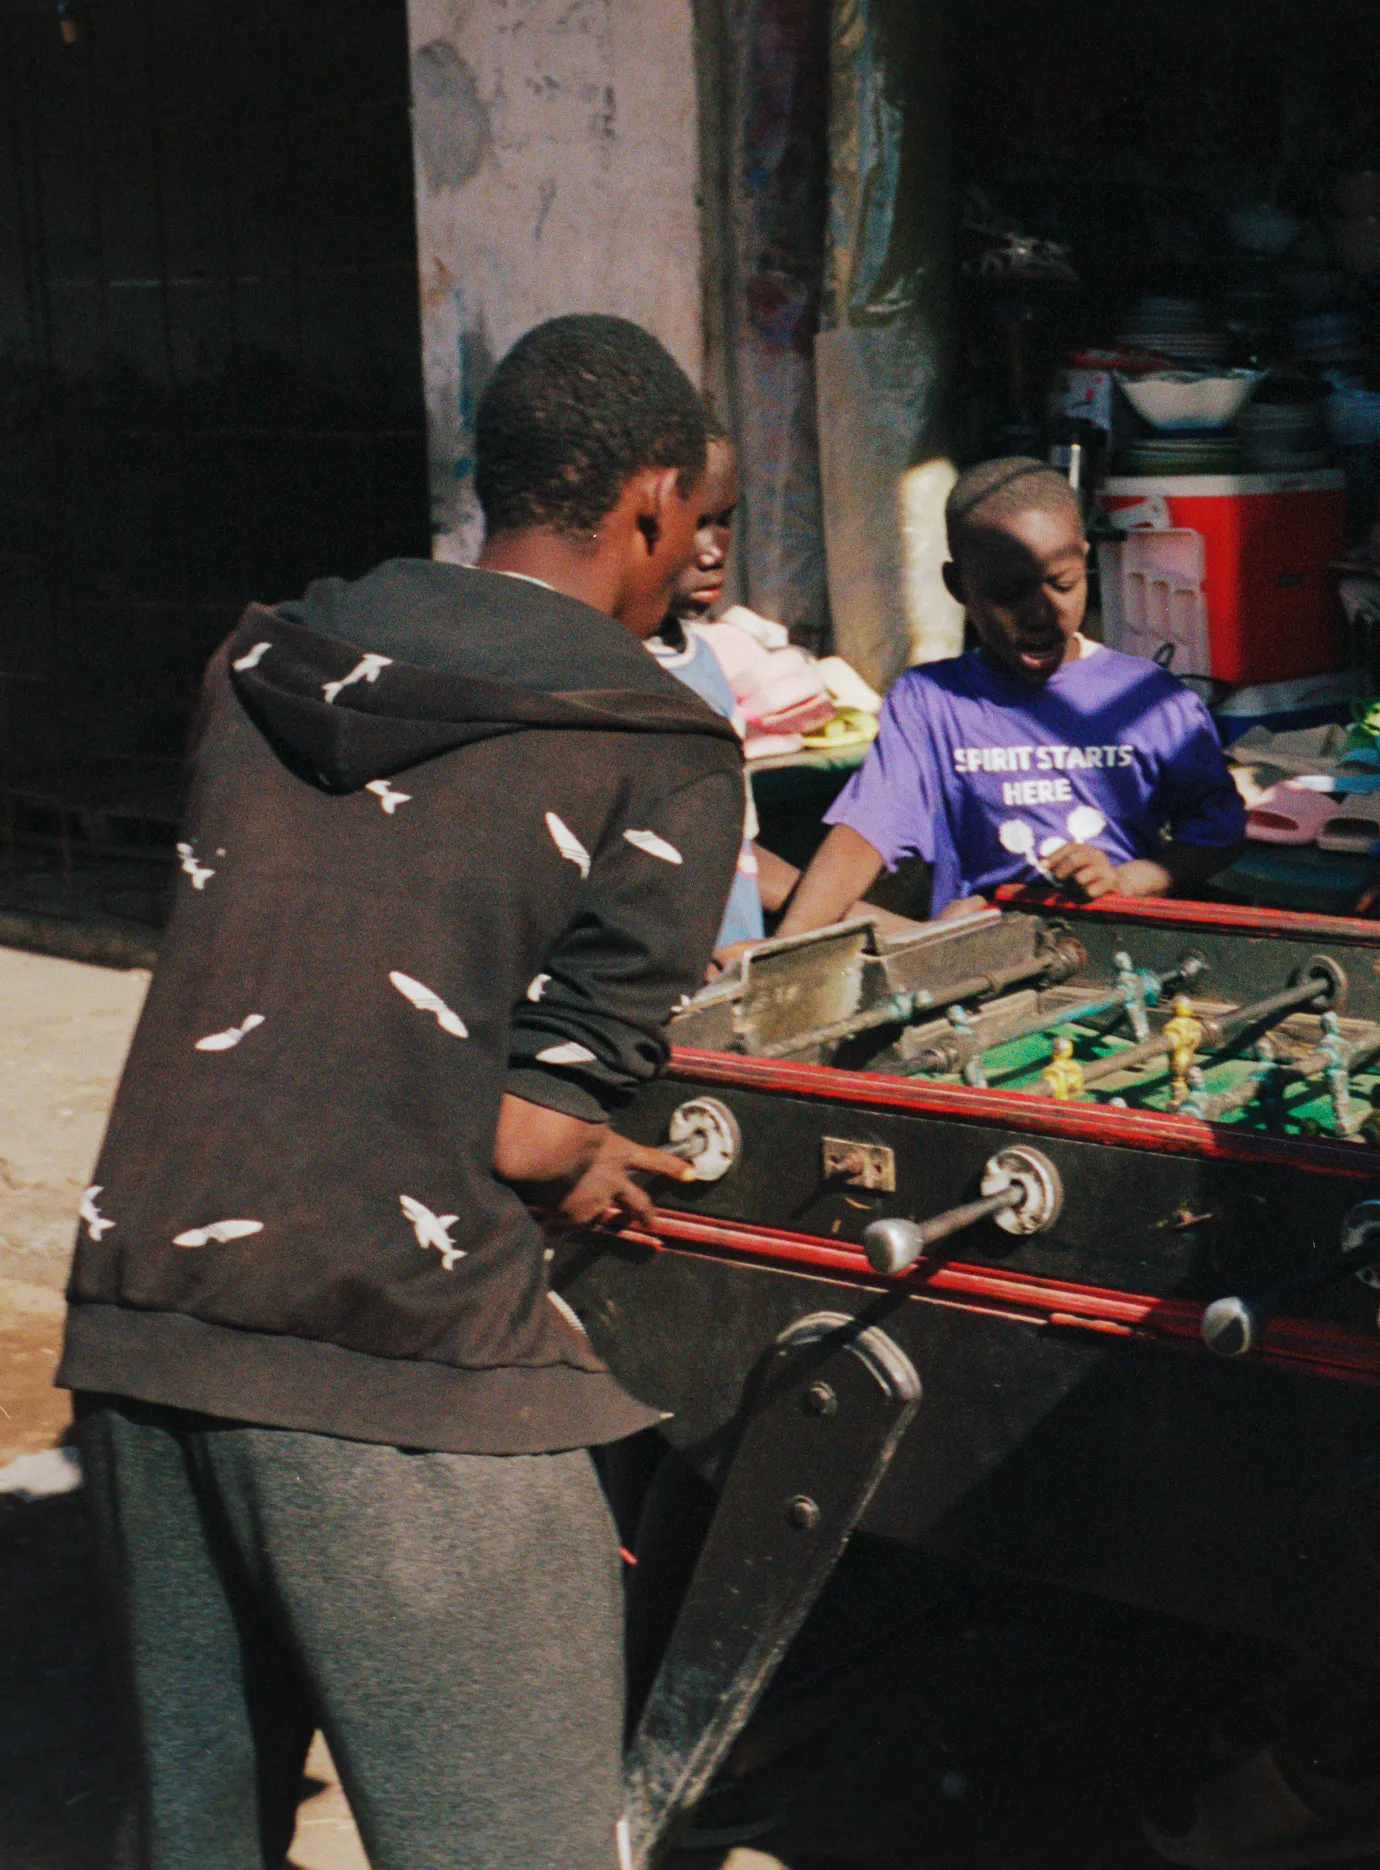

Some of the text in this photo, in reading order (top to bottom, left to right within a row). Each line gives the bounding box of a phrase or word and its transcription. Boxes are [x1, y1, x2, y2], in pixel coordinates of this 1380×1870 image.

[953, 745, 1134, 772] SPIRIT STARTS
[1003, 778, 1072, 805] HERE
